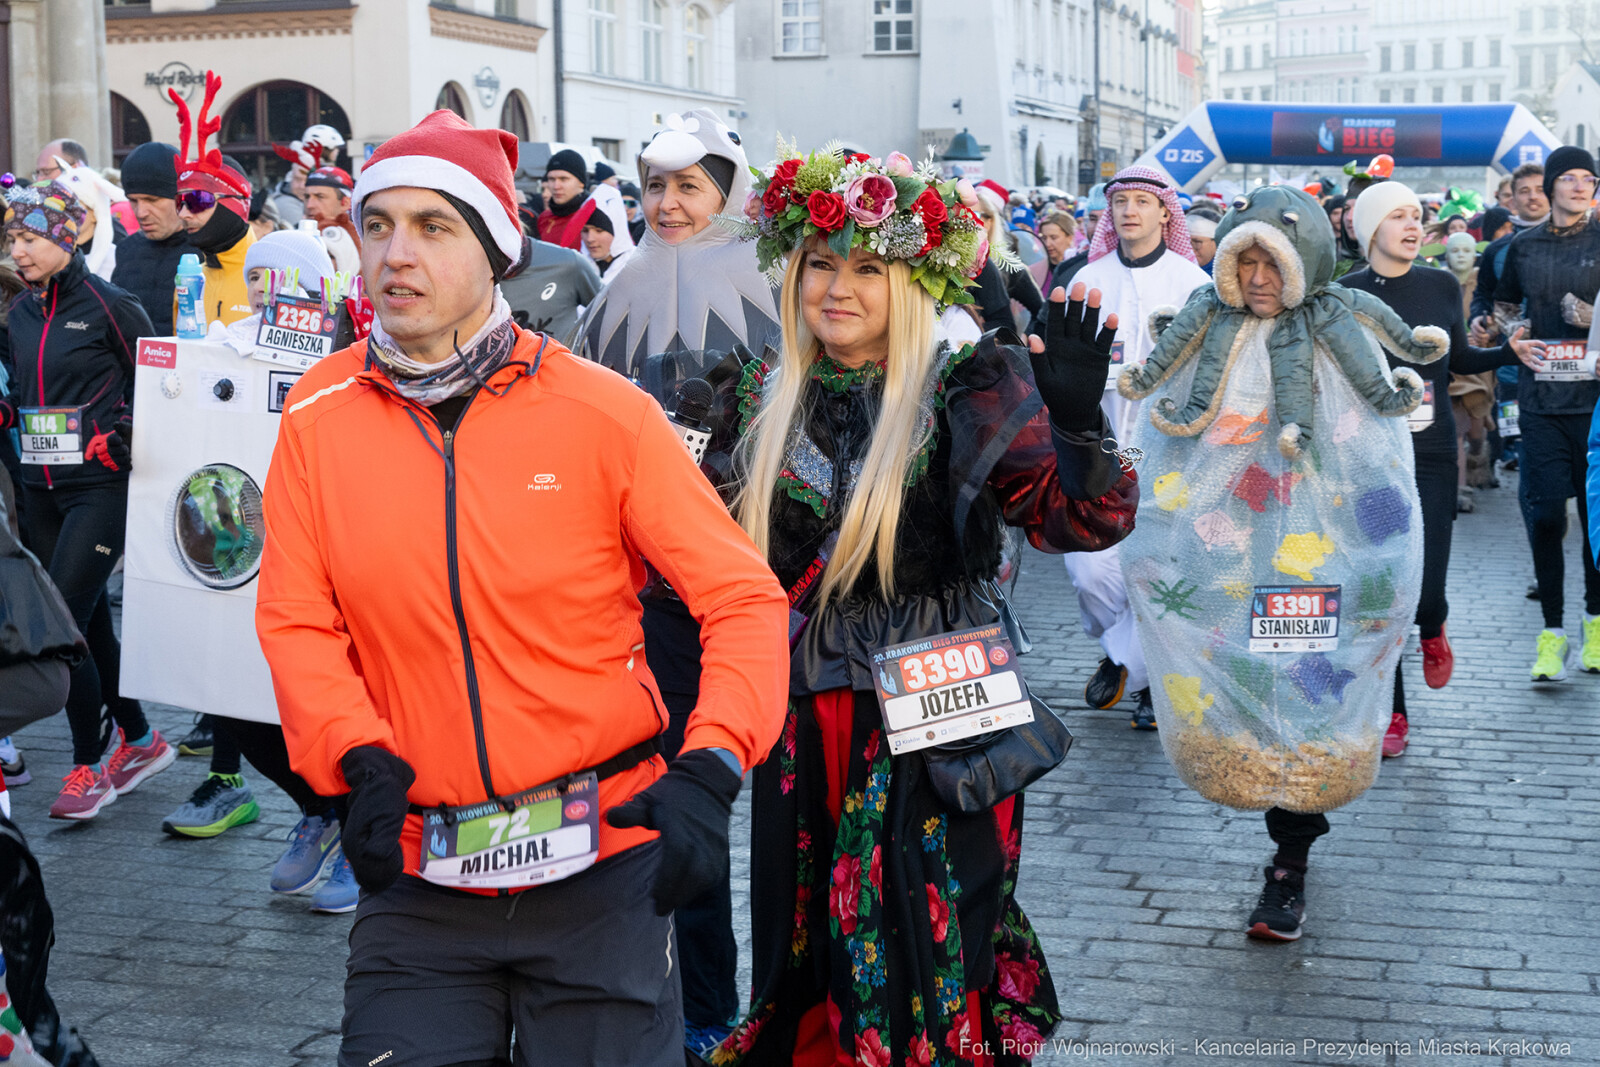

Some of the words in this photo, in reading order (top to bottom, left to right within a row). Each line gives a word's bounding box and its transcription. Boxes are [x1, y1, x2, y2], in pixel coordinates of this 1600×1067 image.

[144, 71, 177, 86] Hard
[1342, 118, 1396, 128] KRAKOWSKI
[1342, 127, 1396, 147] BIEG
[1180, 148, 1204, 163] ZIS
[277, 305, 322, 333] 2326
[265, 328, 324, 354] AGNIESZKA
[143, 345, 172, 358] Amica
[1546, 345, 1584, 359] 2044
[1550, 361, 1580, 371] PAWEŁ
[31, 415, 57, 433] 414
[32, 436, 59, 450] ELENA
[527, 483, 562, 492] Kalenji
[1271, 595, 1320, 616] 3391
[1259, 618, 1331, 635] STANISŁAW
[873, 653, 886, 663] 20.
[886, 641, 933, 660] KRAKOWSKI
[932, 637, 951, 649] BIEG
[951, 627, 1002, 645] SYLWESTROWY
[903, 644, 986, 690] 3390
[919, 682, 990, 720] JÓZEFA
[456, 803, 499, 822] AKOWSKI
[488, 807, 530, 848] 72
[460, 837, 554, 876] MICHAŁ
